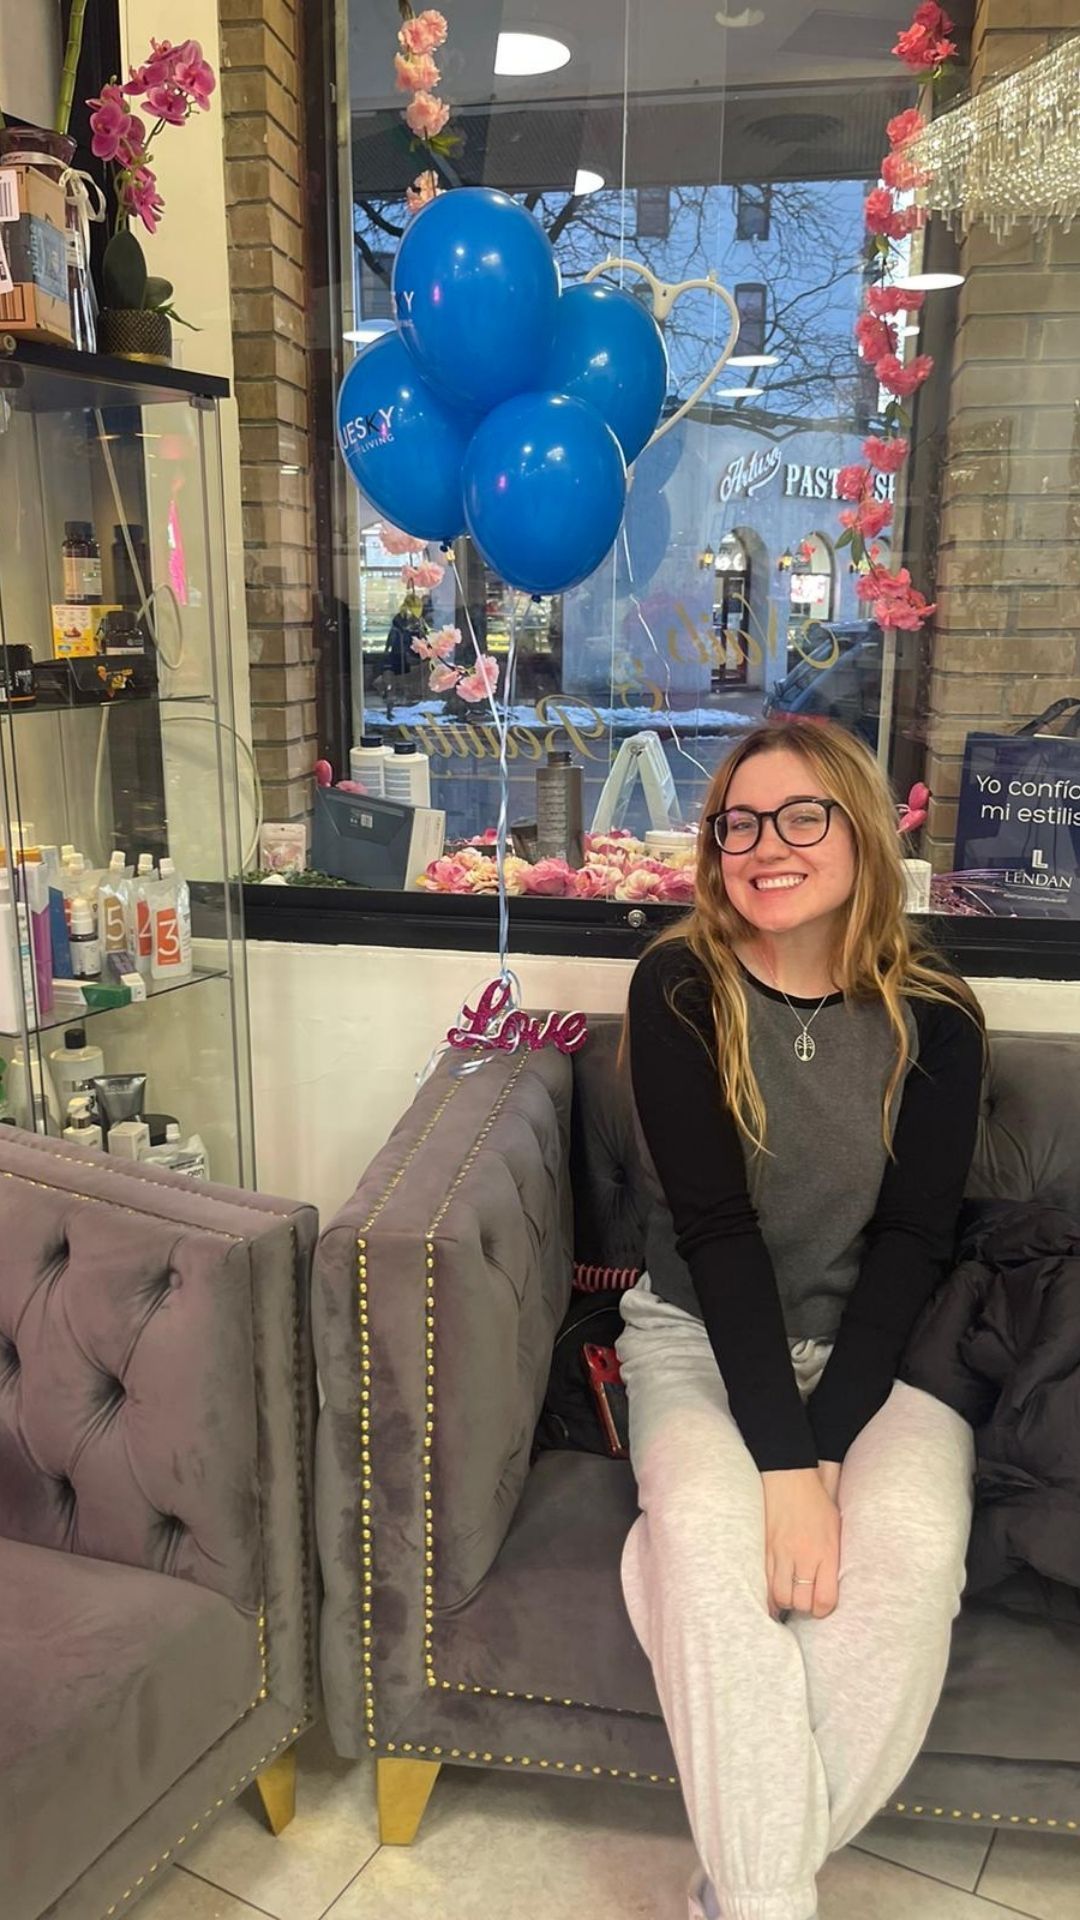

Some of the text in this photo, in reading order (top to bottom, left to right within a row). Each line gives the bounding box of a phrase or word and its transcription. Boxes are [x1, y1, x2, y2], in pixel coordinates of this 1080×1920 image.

[361, 433, 395, 453] LIVING
[975, 774, 1001, 794] Yo
[981, 803, 1010, 820] mi
[1004, 871, 1072, 888] LENDAN
[107, 906, 124, 941] 5
[158, 919, 179, 956] 3
[447, 978, 589, 1054] Love
